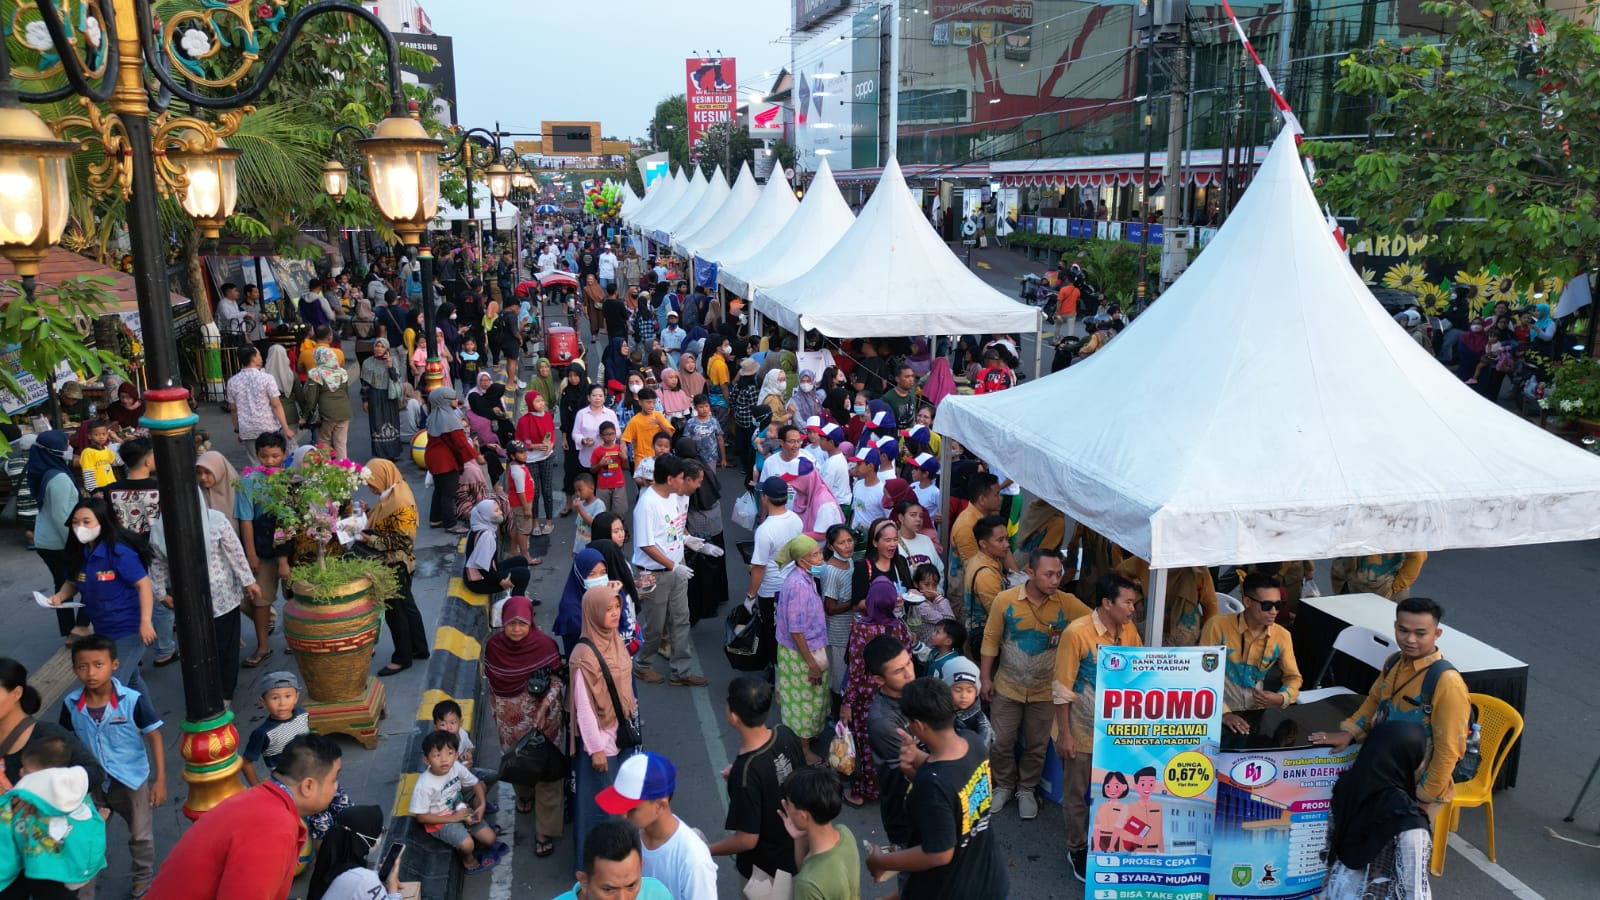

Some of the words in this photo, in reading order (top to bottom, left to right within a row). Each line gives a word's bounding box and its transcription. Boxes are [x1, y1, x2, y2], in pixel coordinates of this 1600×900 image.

[855, 80, 873, 100] oppo
[694, 111, 731, 122] KESINI
[1103, 689, 1215, 720] PROMO
[1107, 724, 1151, 736] KREDIT
[1153, 724, 1208, 736] PEGAWAI
[1164, 737, 1200, 745] MADIUN
[1168, 768, 1210, 782] 0,67%
[1283, 769, 1308, 779] BANK
[1301, 802, 1330, 810] PRODU
[1122, 858, 1162, 866] PROSES
[1165, 858, 1198, 866] CEPAT
[1121, 875, 1163, 883] SYARAT
[1165, 875, 1202, 884] MUDAH
[1120, 891, 1143, 899] BISA
[1146, 891, 1173, 899] TAKE
[1175, 892, 1203, 900] OVER
